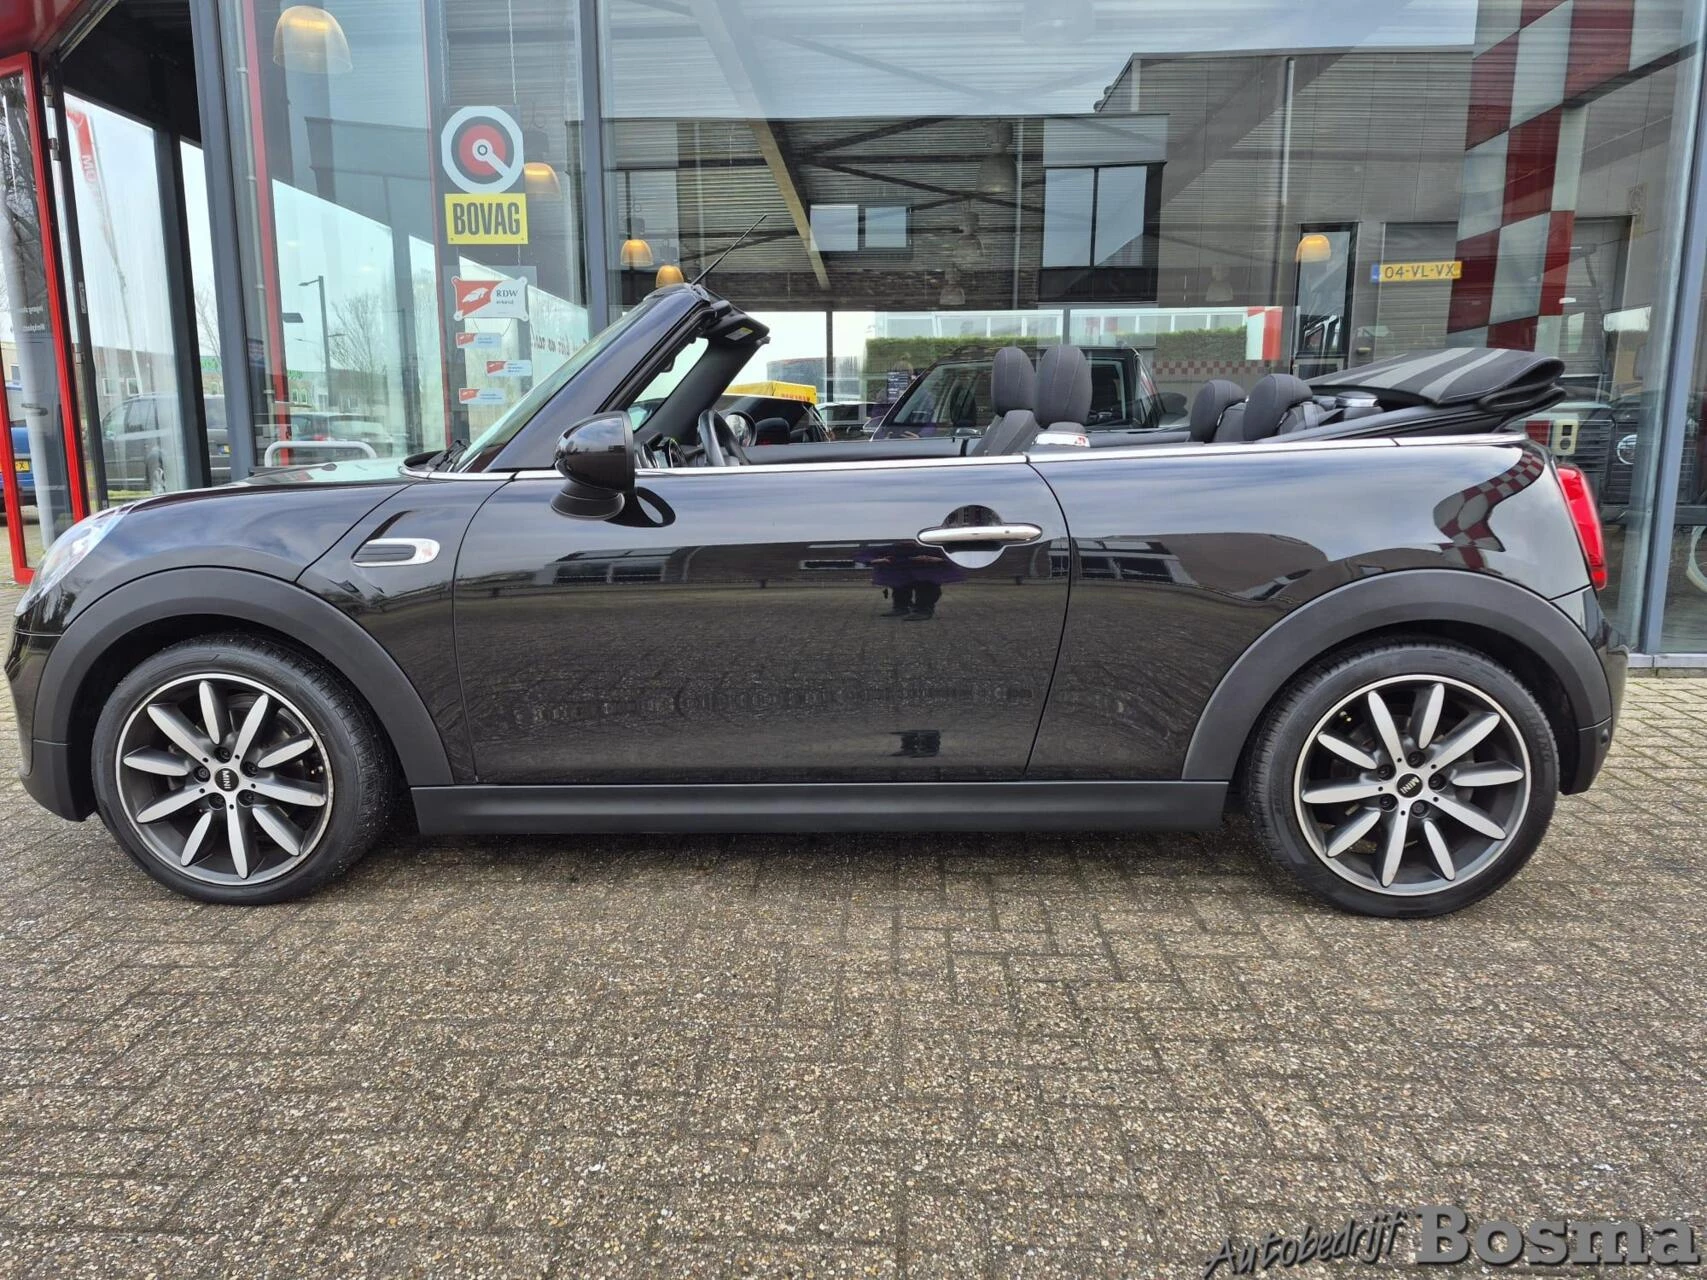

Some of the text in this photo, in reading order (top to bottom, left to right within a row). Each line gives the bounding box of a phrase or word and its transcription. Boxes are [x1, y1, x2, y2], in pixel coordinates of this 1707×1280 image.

[452, 202, 521, 236] BOVAG
[1384, 263, 1456, 279] 04-VL-VX
[496, 289, 519, 297] RDW
[222, 770, 232, 789] MINI
[1400, 776, 1421, 794] MINI
